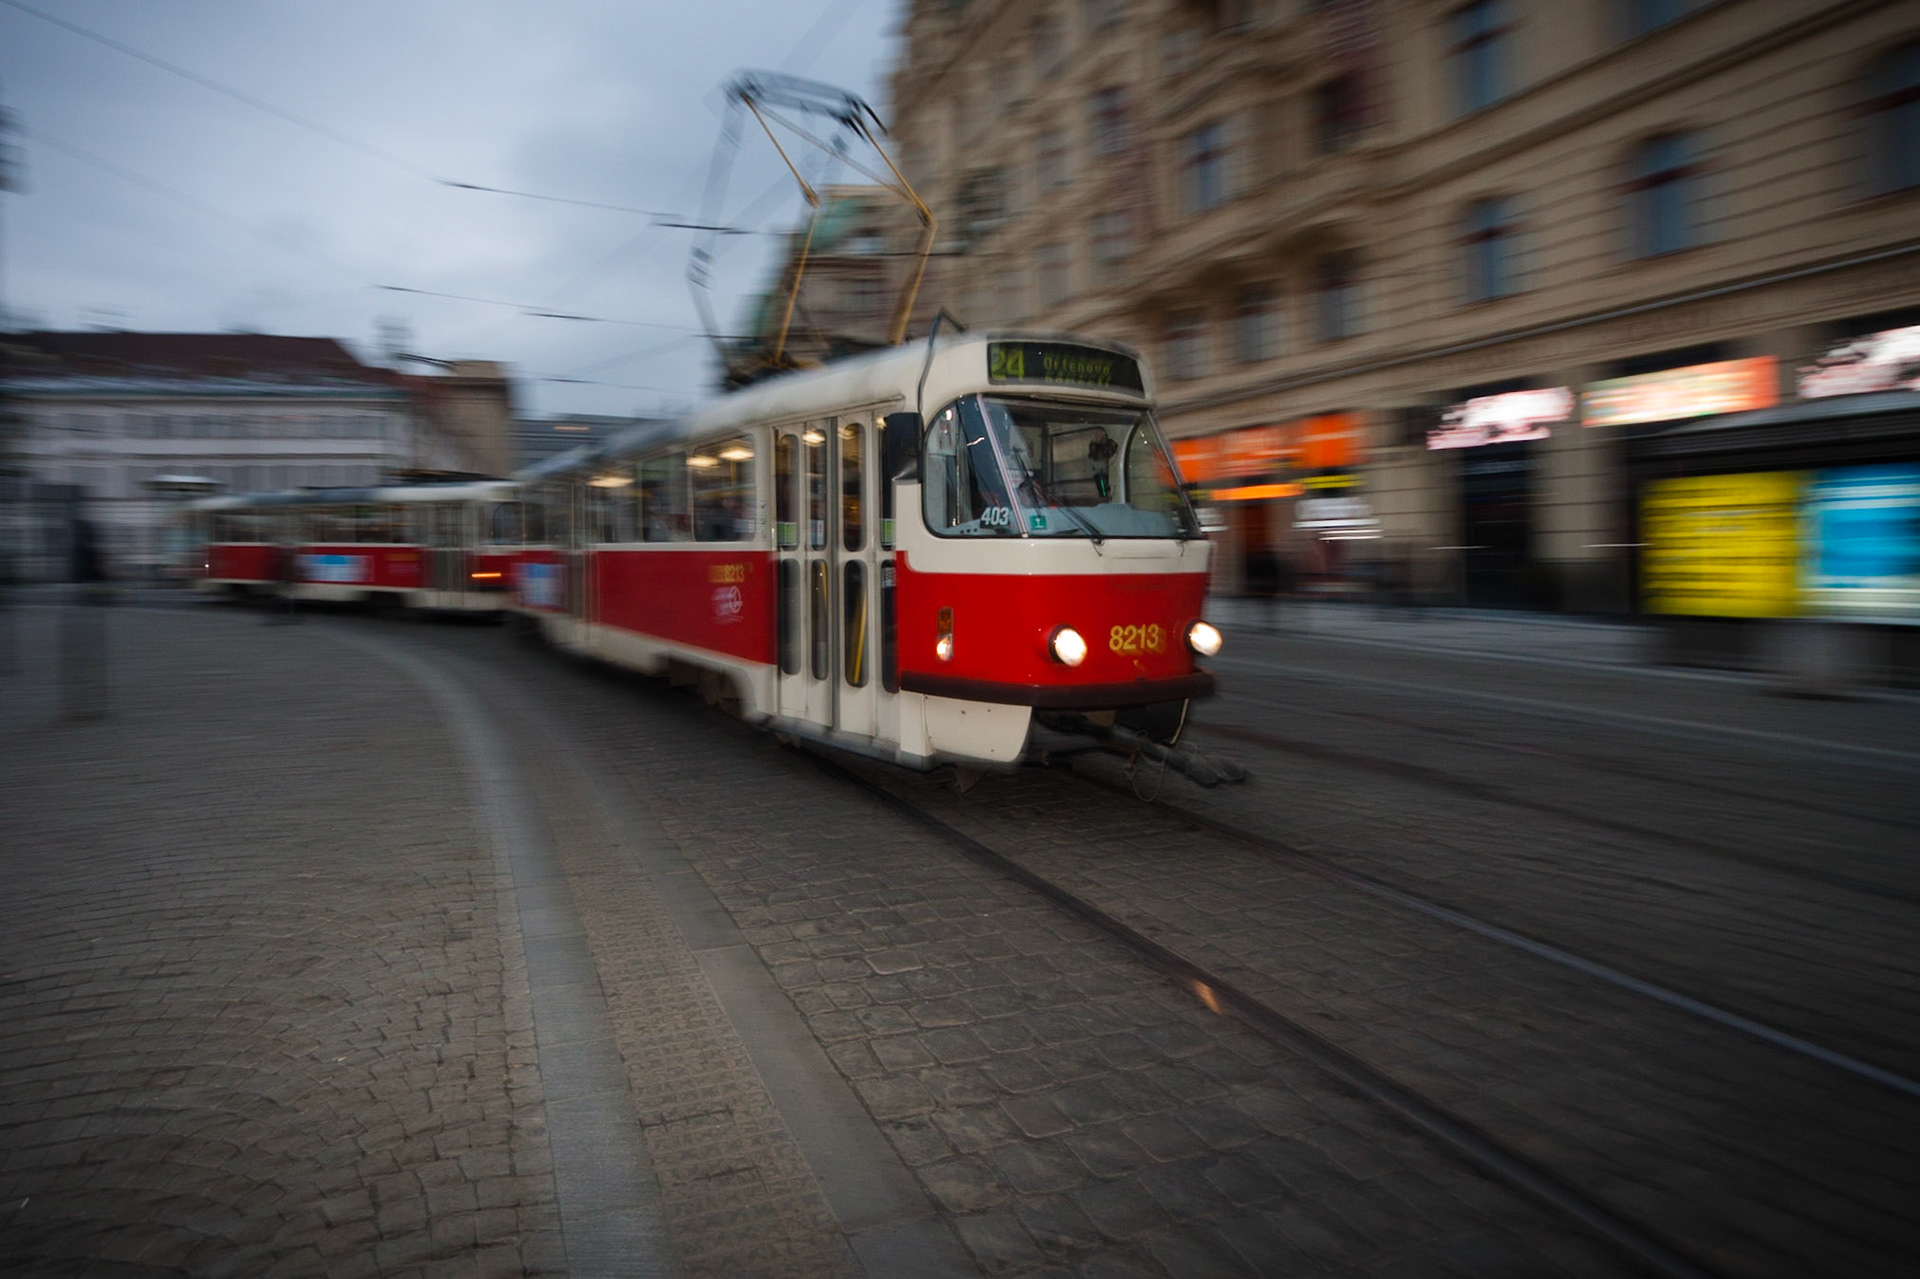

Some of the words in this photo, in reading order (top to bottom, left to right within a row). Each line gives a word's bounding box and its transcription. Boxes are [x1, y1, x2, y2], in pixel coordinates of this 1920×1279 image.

[991, 348, 1024, 382] 24
[981, 507, 1009, 526] 403
[1109, 624, 1160, 651] 8213
